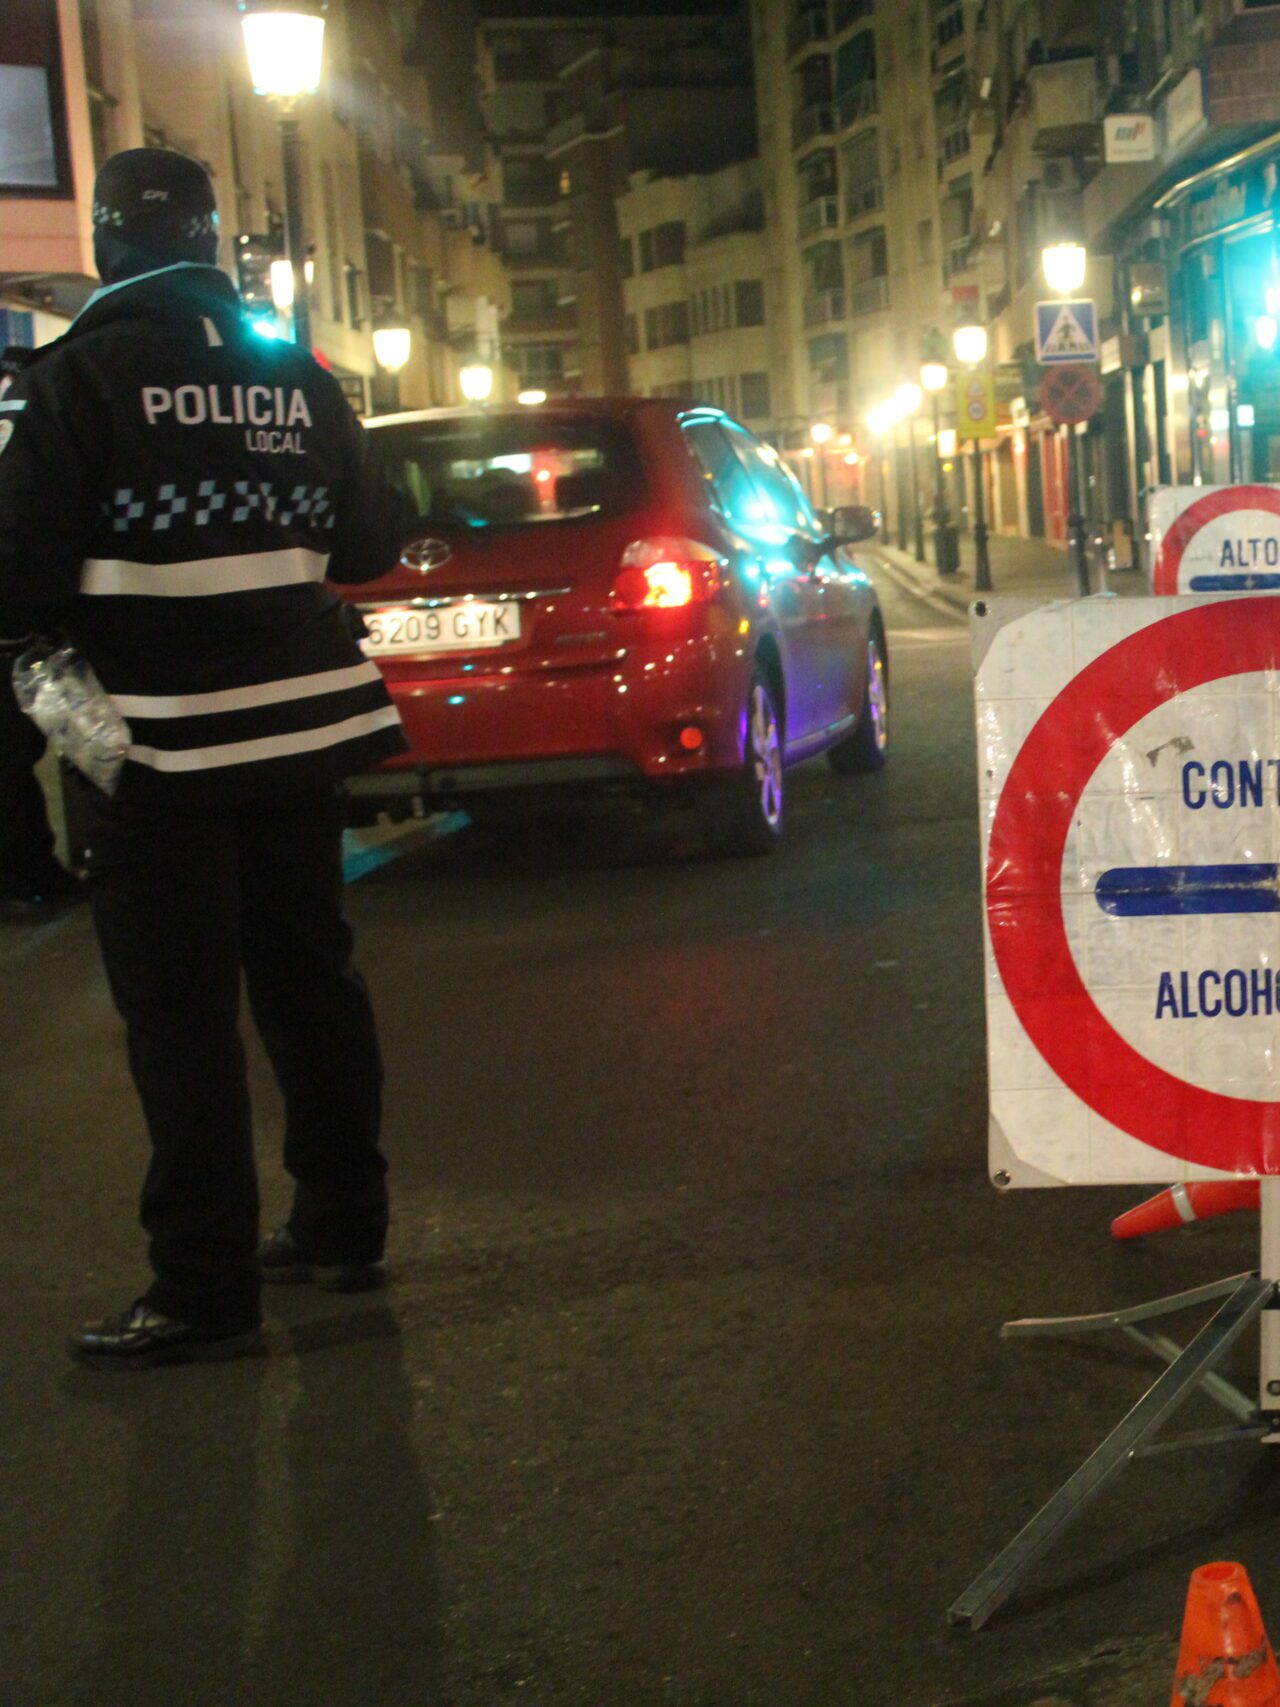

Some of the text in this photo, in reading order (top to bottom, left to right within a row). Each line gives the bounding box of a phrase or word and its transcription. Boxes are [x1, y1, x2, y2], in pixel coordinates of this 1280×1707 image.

[141, 384, 313, 428] POLICIA
[245, 430, 306, 455] LOCAL
[1220, 537, 1279, 567] ALTO
[453, 608, 509, 638] GYK
